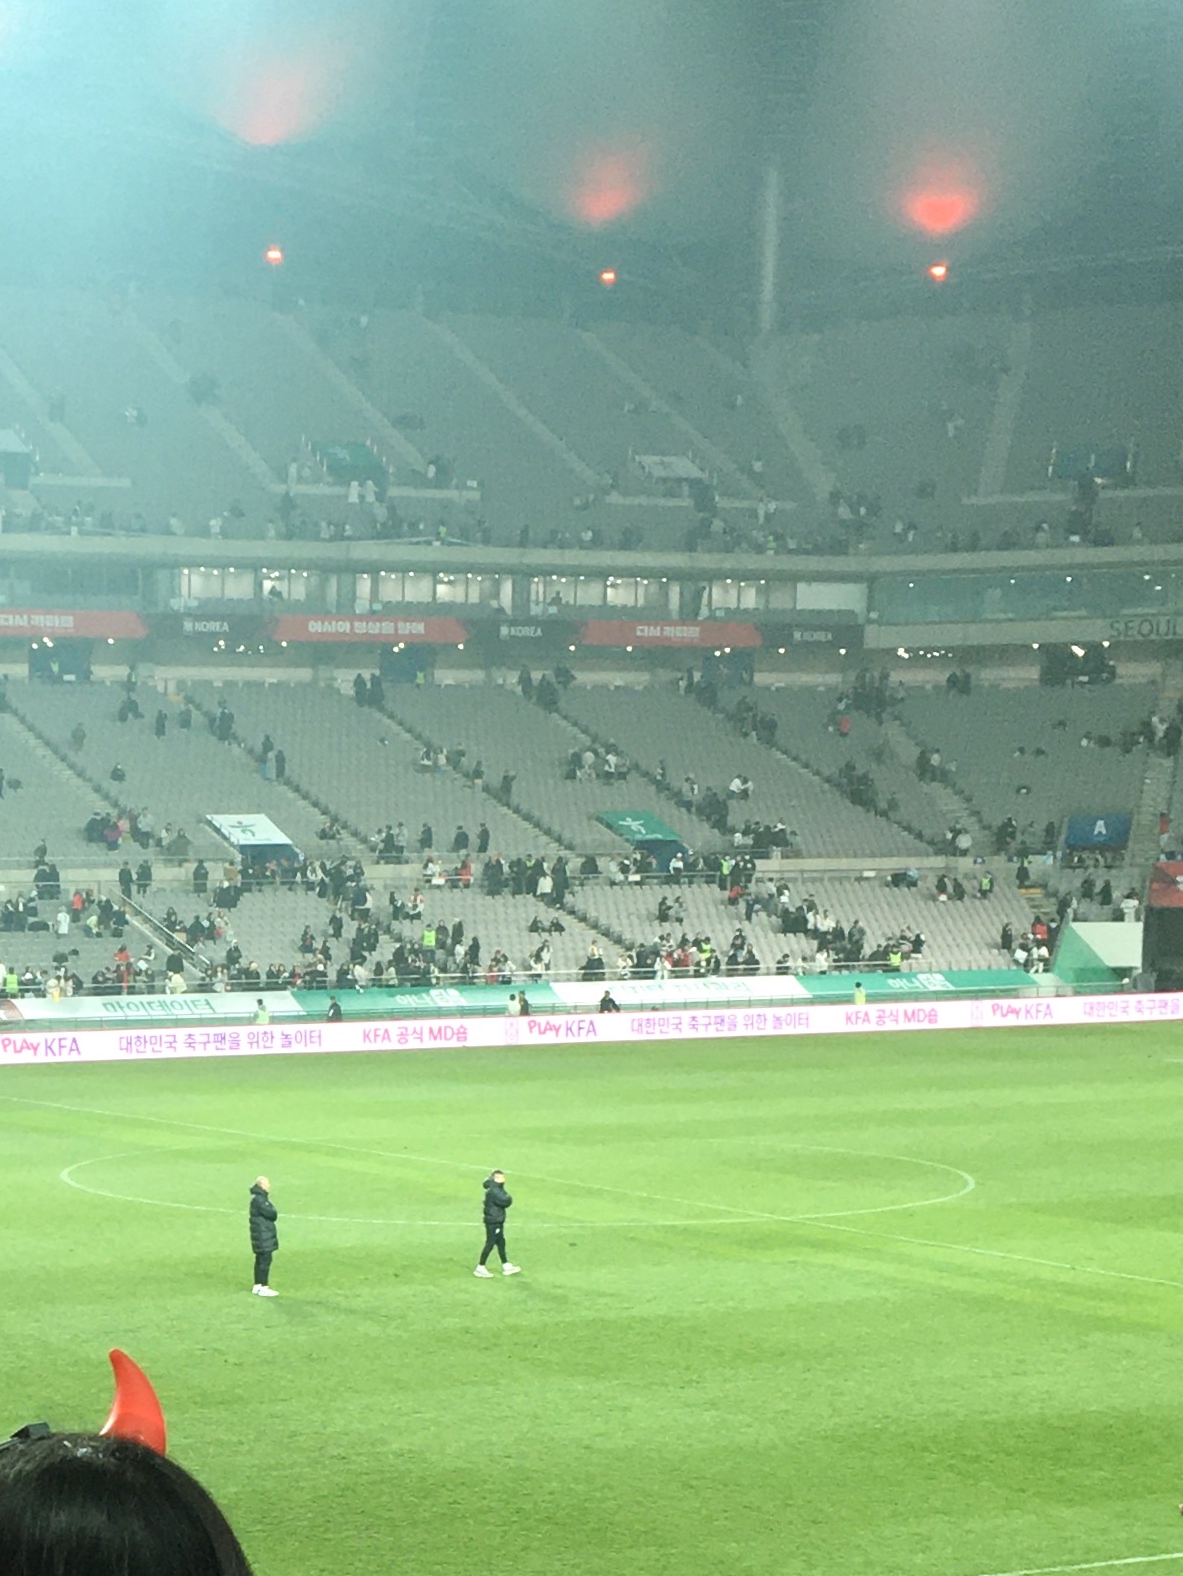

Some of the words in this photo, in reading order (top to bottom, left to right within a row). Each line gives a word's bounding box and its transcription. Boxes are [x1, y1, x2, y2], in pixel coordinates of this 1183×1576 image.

[194, 621, 229, 633] KOREA
[510, 626, 543, 638] KOREA
[1110, 618, 1181, 638] SEOUL
[1093, 819, 1107, 835] A
[102, 998, 216, 1015] 마이데이터
[1024, 1003, 1054, 1019] KFA
[1083, 1000, 1130, 1017] 대한민국
[1135, 998, 1180, 1015] 축구팬을
[631, 1016, 682, 1035] 대한민국
[688, 1015, 737, 1032] 축구팬을
[743, 1014, 767, 1030] 위한
[773, 1012, 809, 1030] 놀이터
[846, 1011, 870, 1025] KFA
[876, 1009, 899, 1026] 공식
[363, 1028, 391, 1043] KFA
[397, 1026, 423, 1045] 공식
[566, 1020, 596, 1037] KFA
[45, 1037, 81, 1056] KFA
[119, 1034, 177, 1053] 대한민국
[184, 1032, 240, 1051] 축구팬을
[247, 1031, 274, 1049] 위한
[281, 1030, 321, 1048] 놀이터
